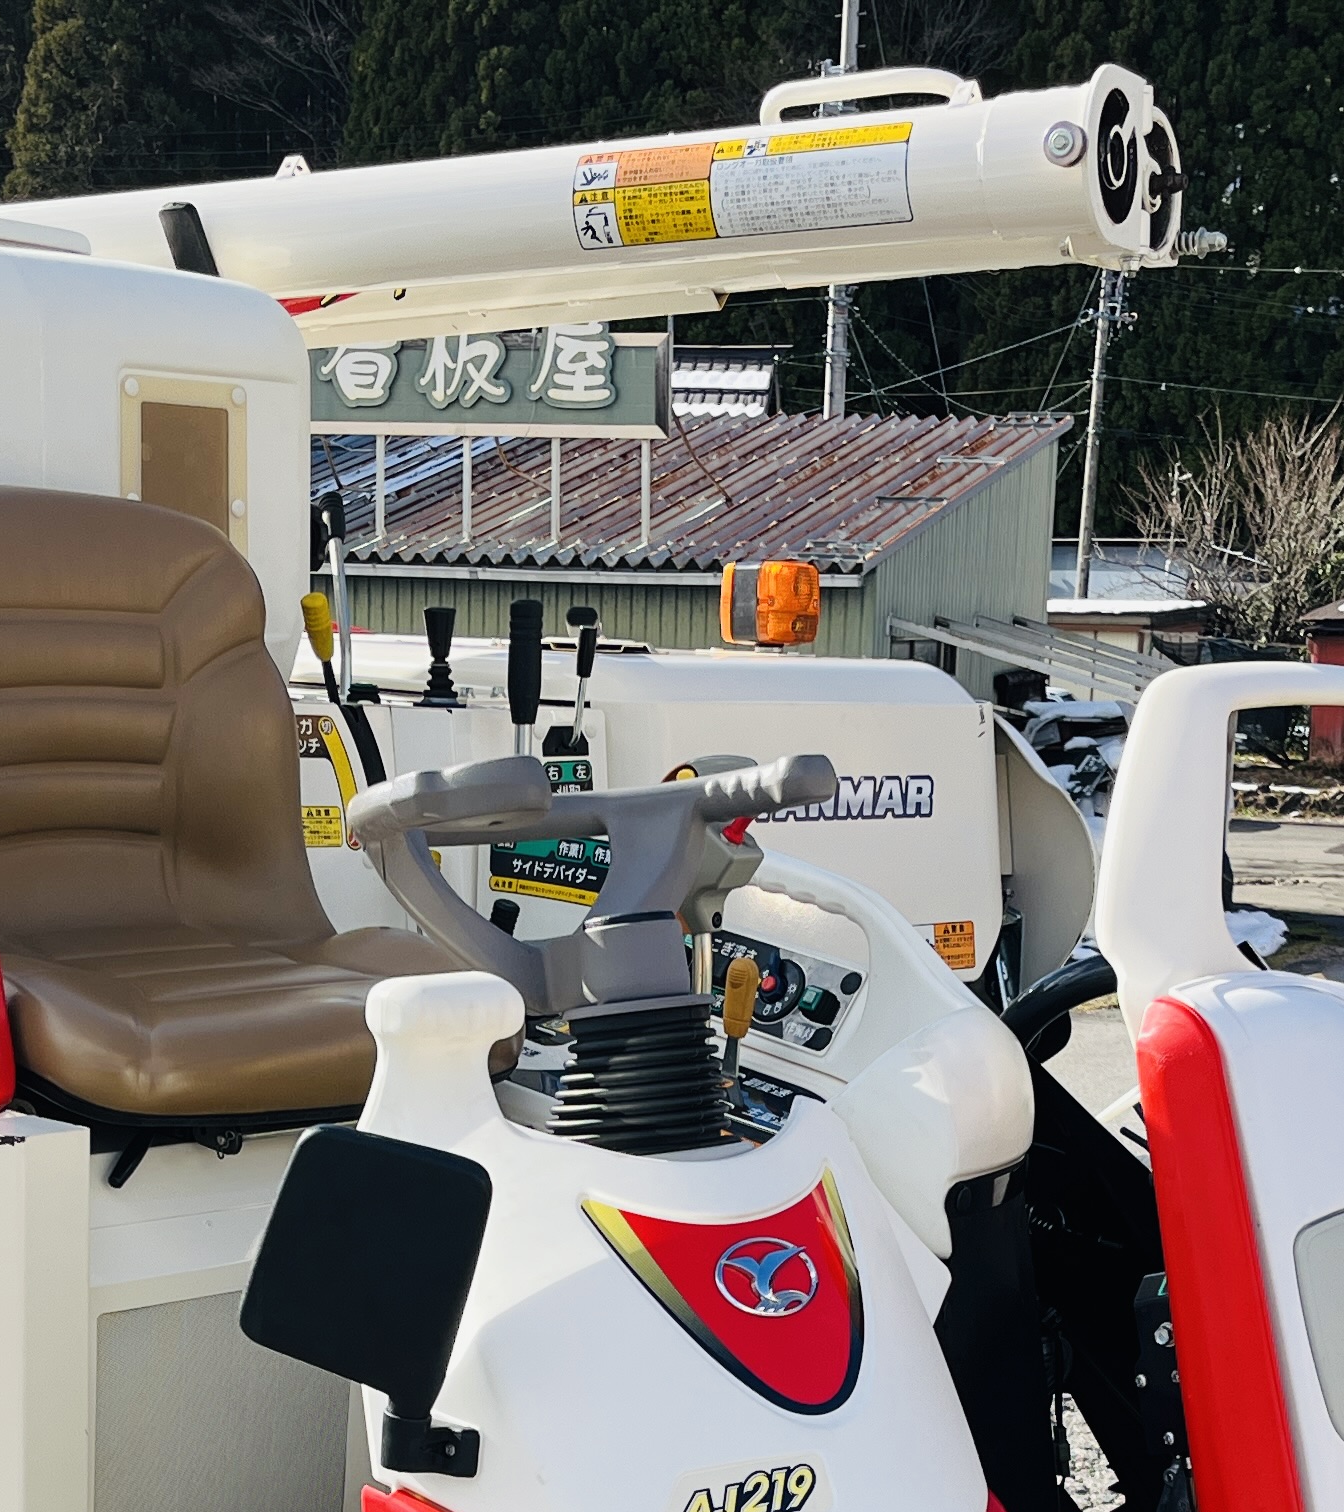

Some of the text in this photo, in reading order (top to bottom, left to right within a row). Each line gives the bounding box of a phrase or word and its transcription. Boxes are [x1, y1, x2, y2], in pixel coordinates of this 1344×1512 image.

[547, 766, 559, 781] 右
[576, 765, 587, 779] 左
[513, 858, 598, 884] サイドデバイダー
